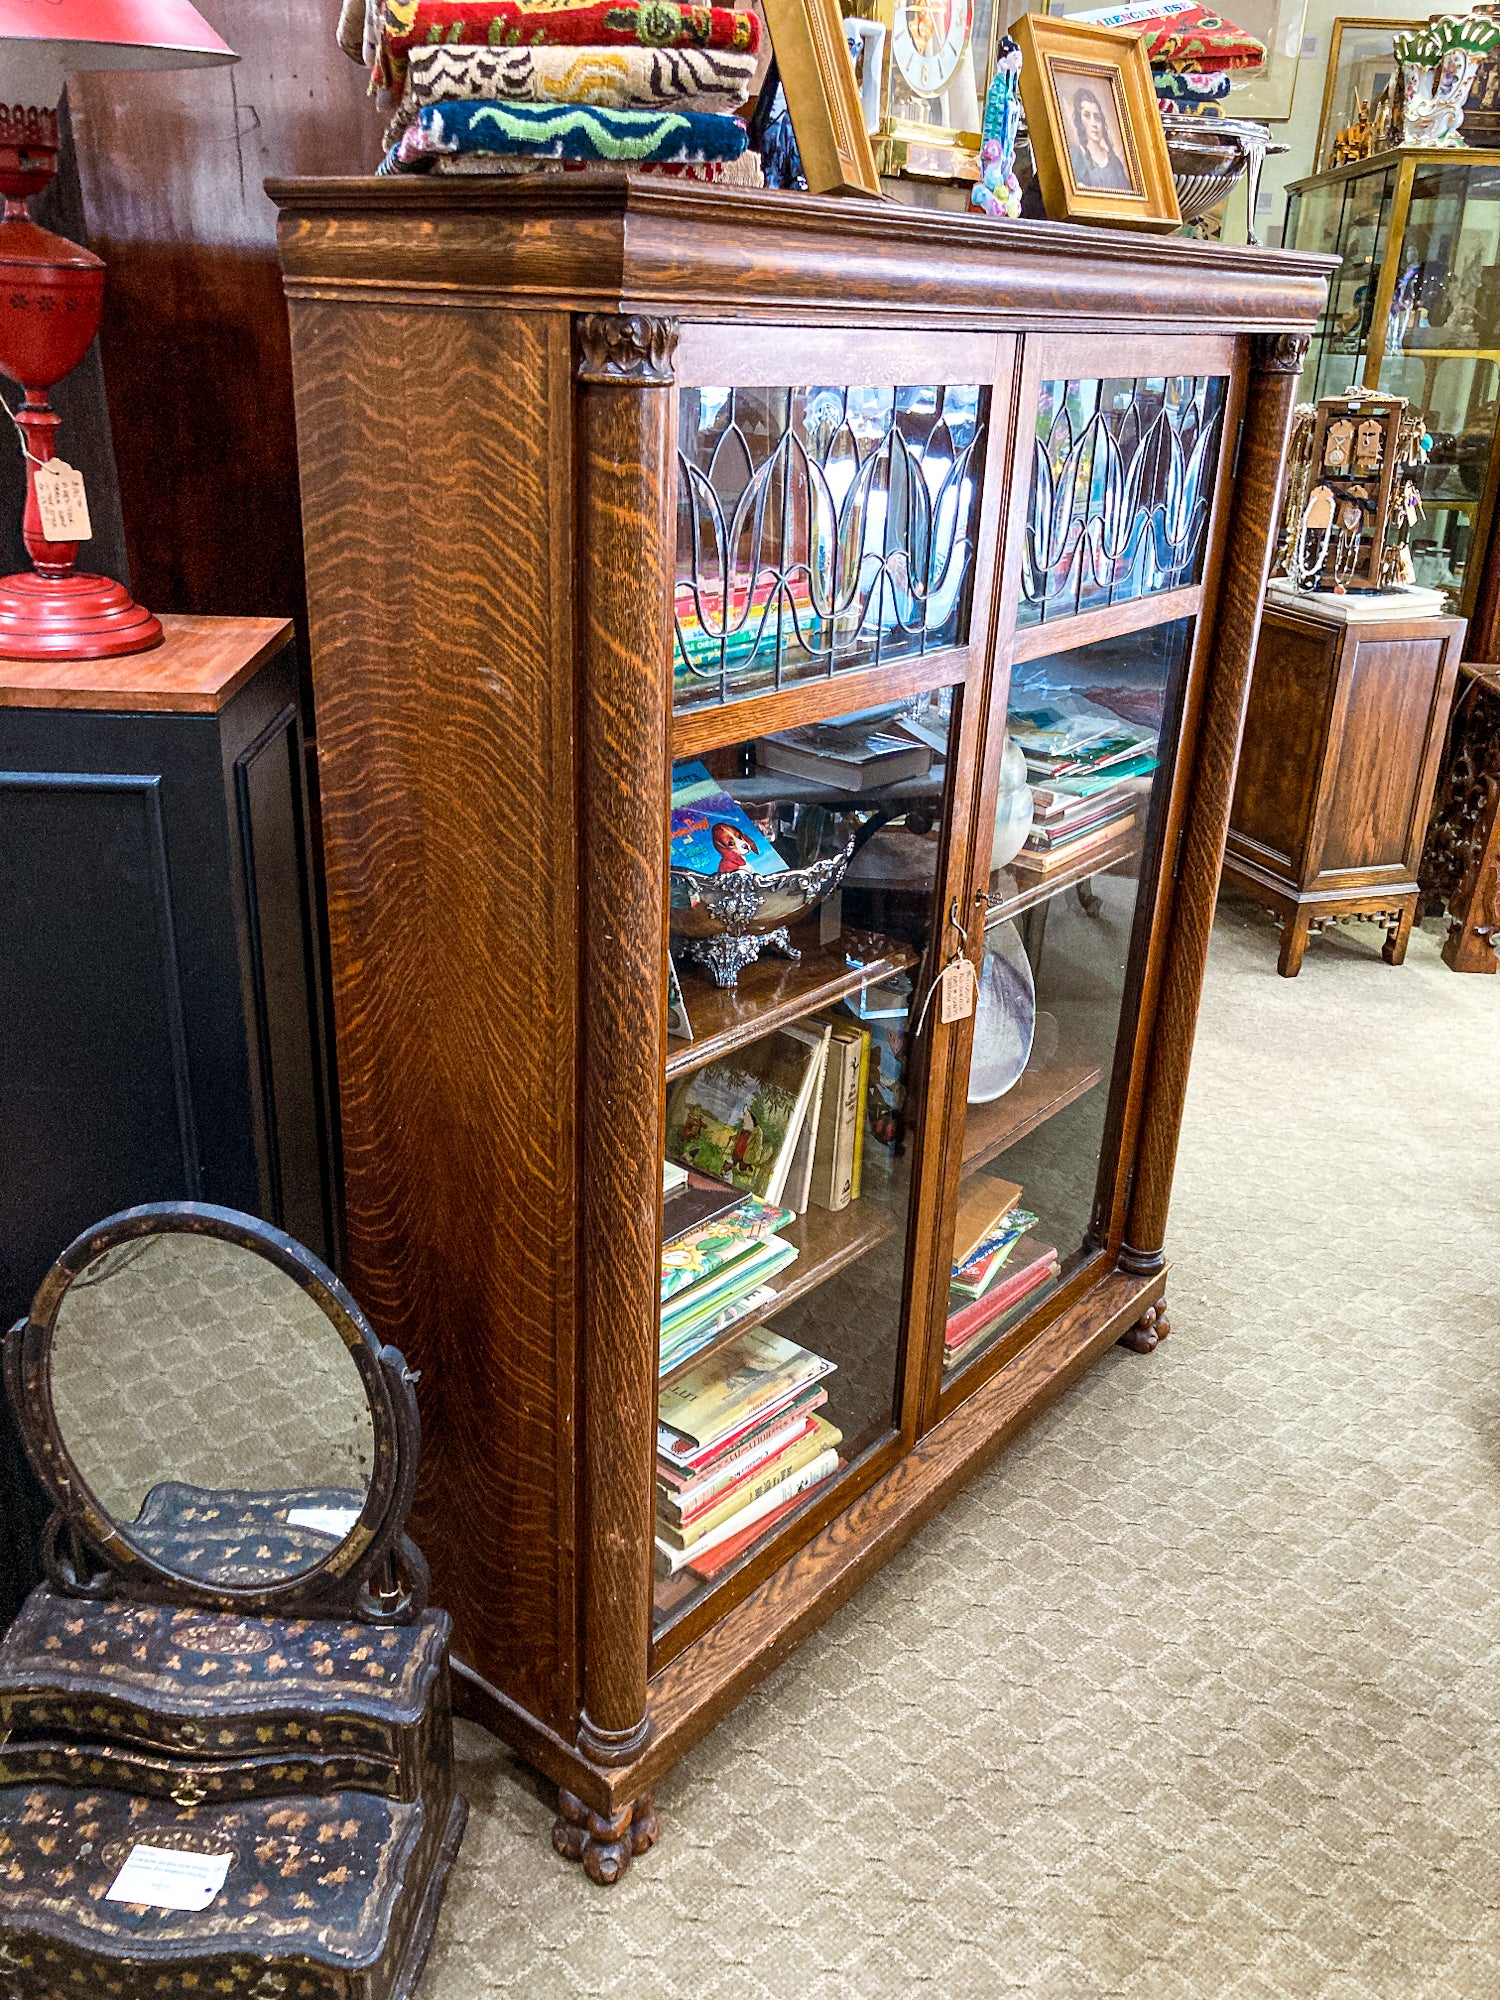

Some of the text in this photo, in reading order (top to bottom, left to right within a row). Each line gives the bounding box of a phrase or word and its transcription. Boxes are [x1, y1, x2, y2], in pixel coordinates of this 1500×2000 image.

[1094, 2, 1189, 27] ARENCE HOUSE
[920, 64, 928, 87] 6
